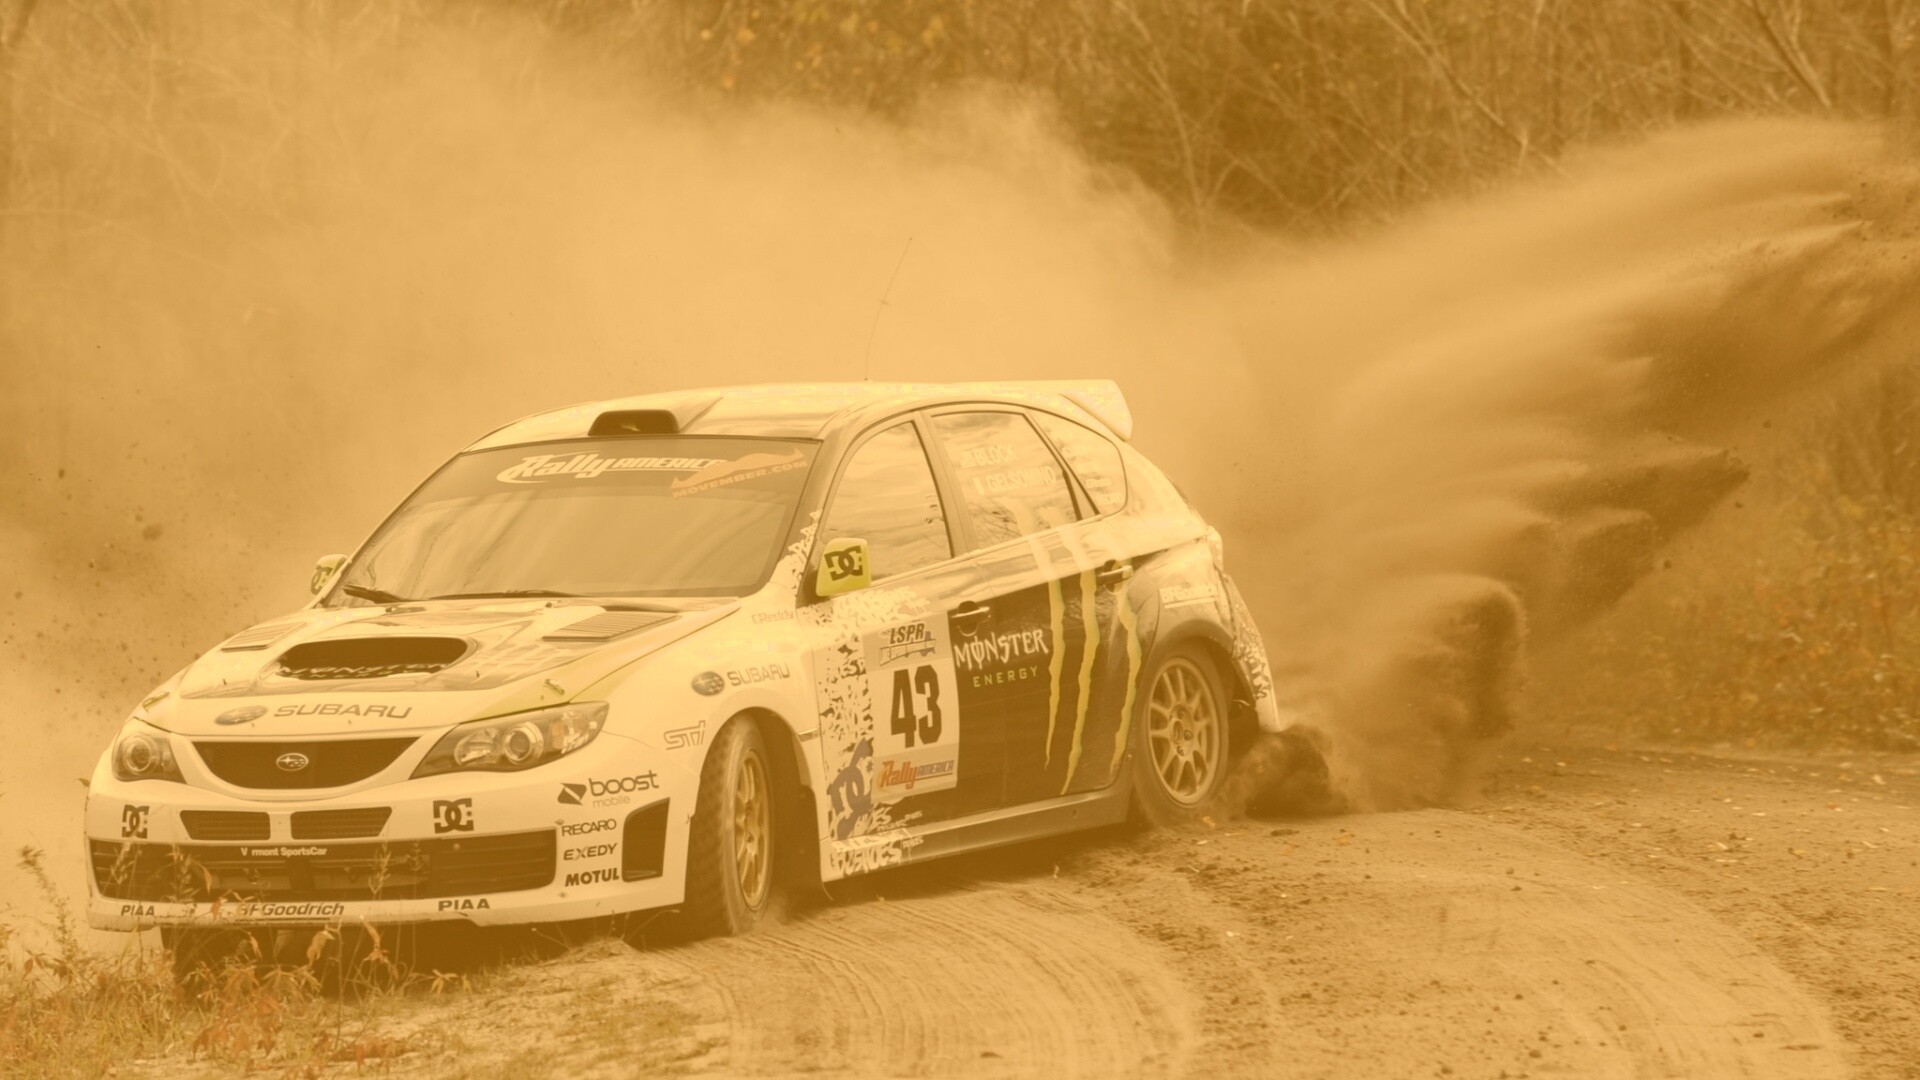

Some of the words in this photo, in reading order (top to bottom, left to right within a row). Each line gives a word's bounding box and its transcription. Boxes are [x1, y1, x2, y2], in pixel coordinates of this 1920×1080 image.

[510, 451, 614, 479] Rally
[607, 457, 727, 470] AMERIC
[672, 460, 808, 499] MOVEMBER.COM
[954, 629, 1049, 671] MONSTER
[727, 663, 790, 687] SUBARU
[973, 665, 1038, 688] ENERGY
[273, 703, 413, 720] SUBARU
[890, 664, 942, 748] 43
[588, 769, 660, 797] boost
[880, 760, 917, 790] Rally
[592, 795, 631, 809] mobile
[561, 818, 617, 837] RECARO
[240, 847, 279, 856] Vrmont
[280, 846, 328, 858] SportsCar
[563, 843, 618, 861] EXEDY
[564, 867, 620, 887] MOTUL
[121, 904, 156, 917] PIAA
[438, 898, 491, 912] PIAA
